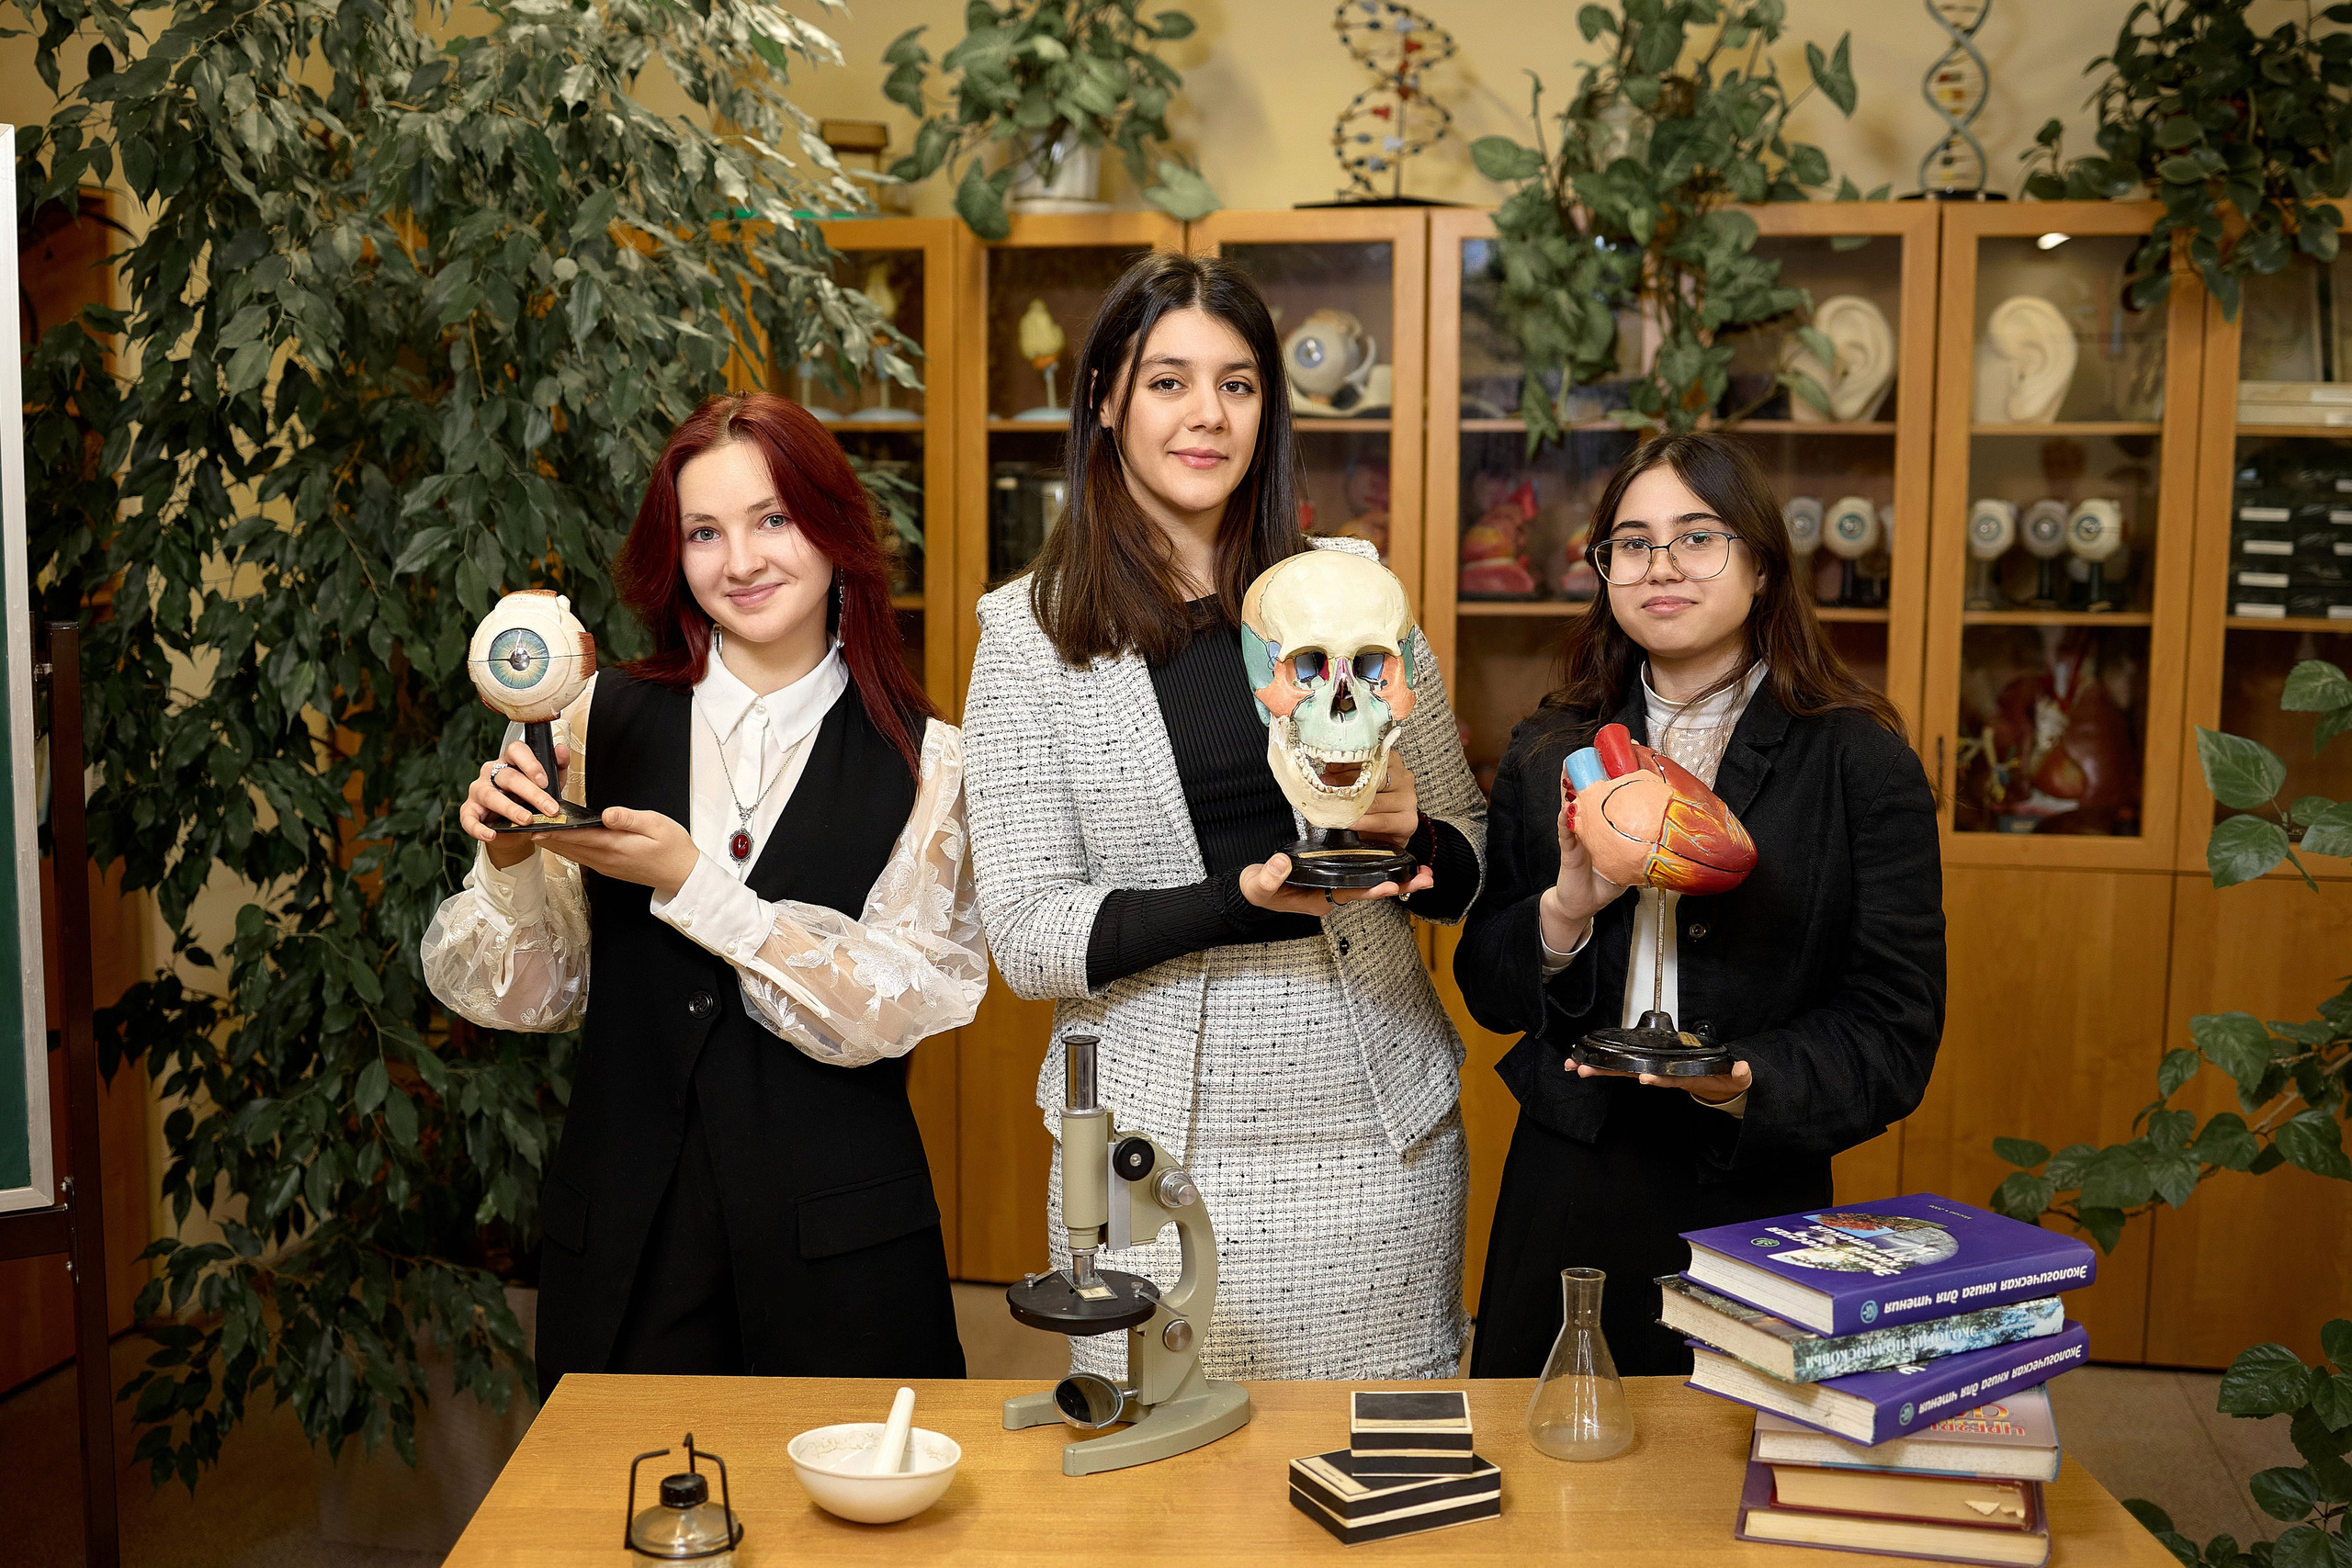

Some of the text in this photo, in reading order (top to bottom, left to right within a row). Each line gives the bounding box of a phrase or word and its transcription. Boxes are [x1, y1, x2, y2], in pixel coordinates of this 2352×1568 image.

[1883, 1265, 2088, 1314] Экологическая книга для чтения
[1909, 1325, 1979, 1348] ЭКОЛОГИЯ
[1805, 1339, 1906, 1370] ПОДМОСКОВЬЯ
[2011, 1344, 2083, 1379] Экологическая
[1960, 1382, 1979, 1397] для
[1981, 1371, 2010, 1390] книга
[1917, 1388, 1959, 1415] чтения
